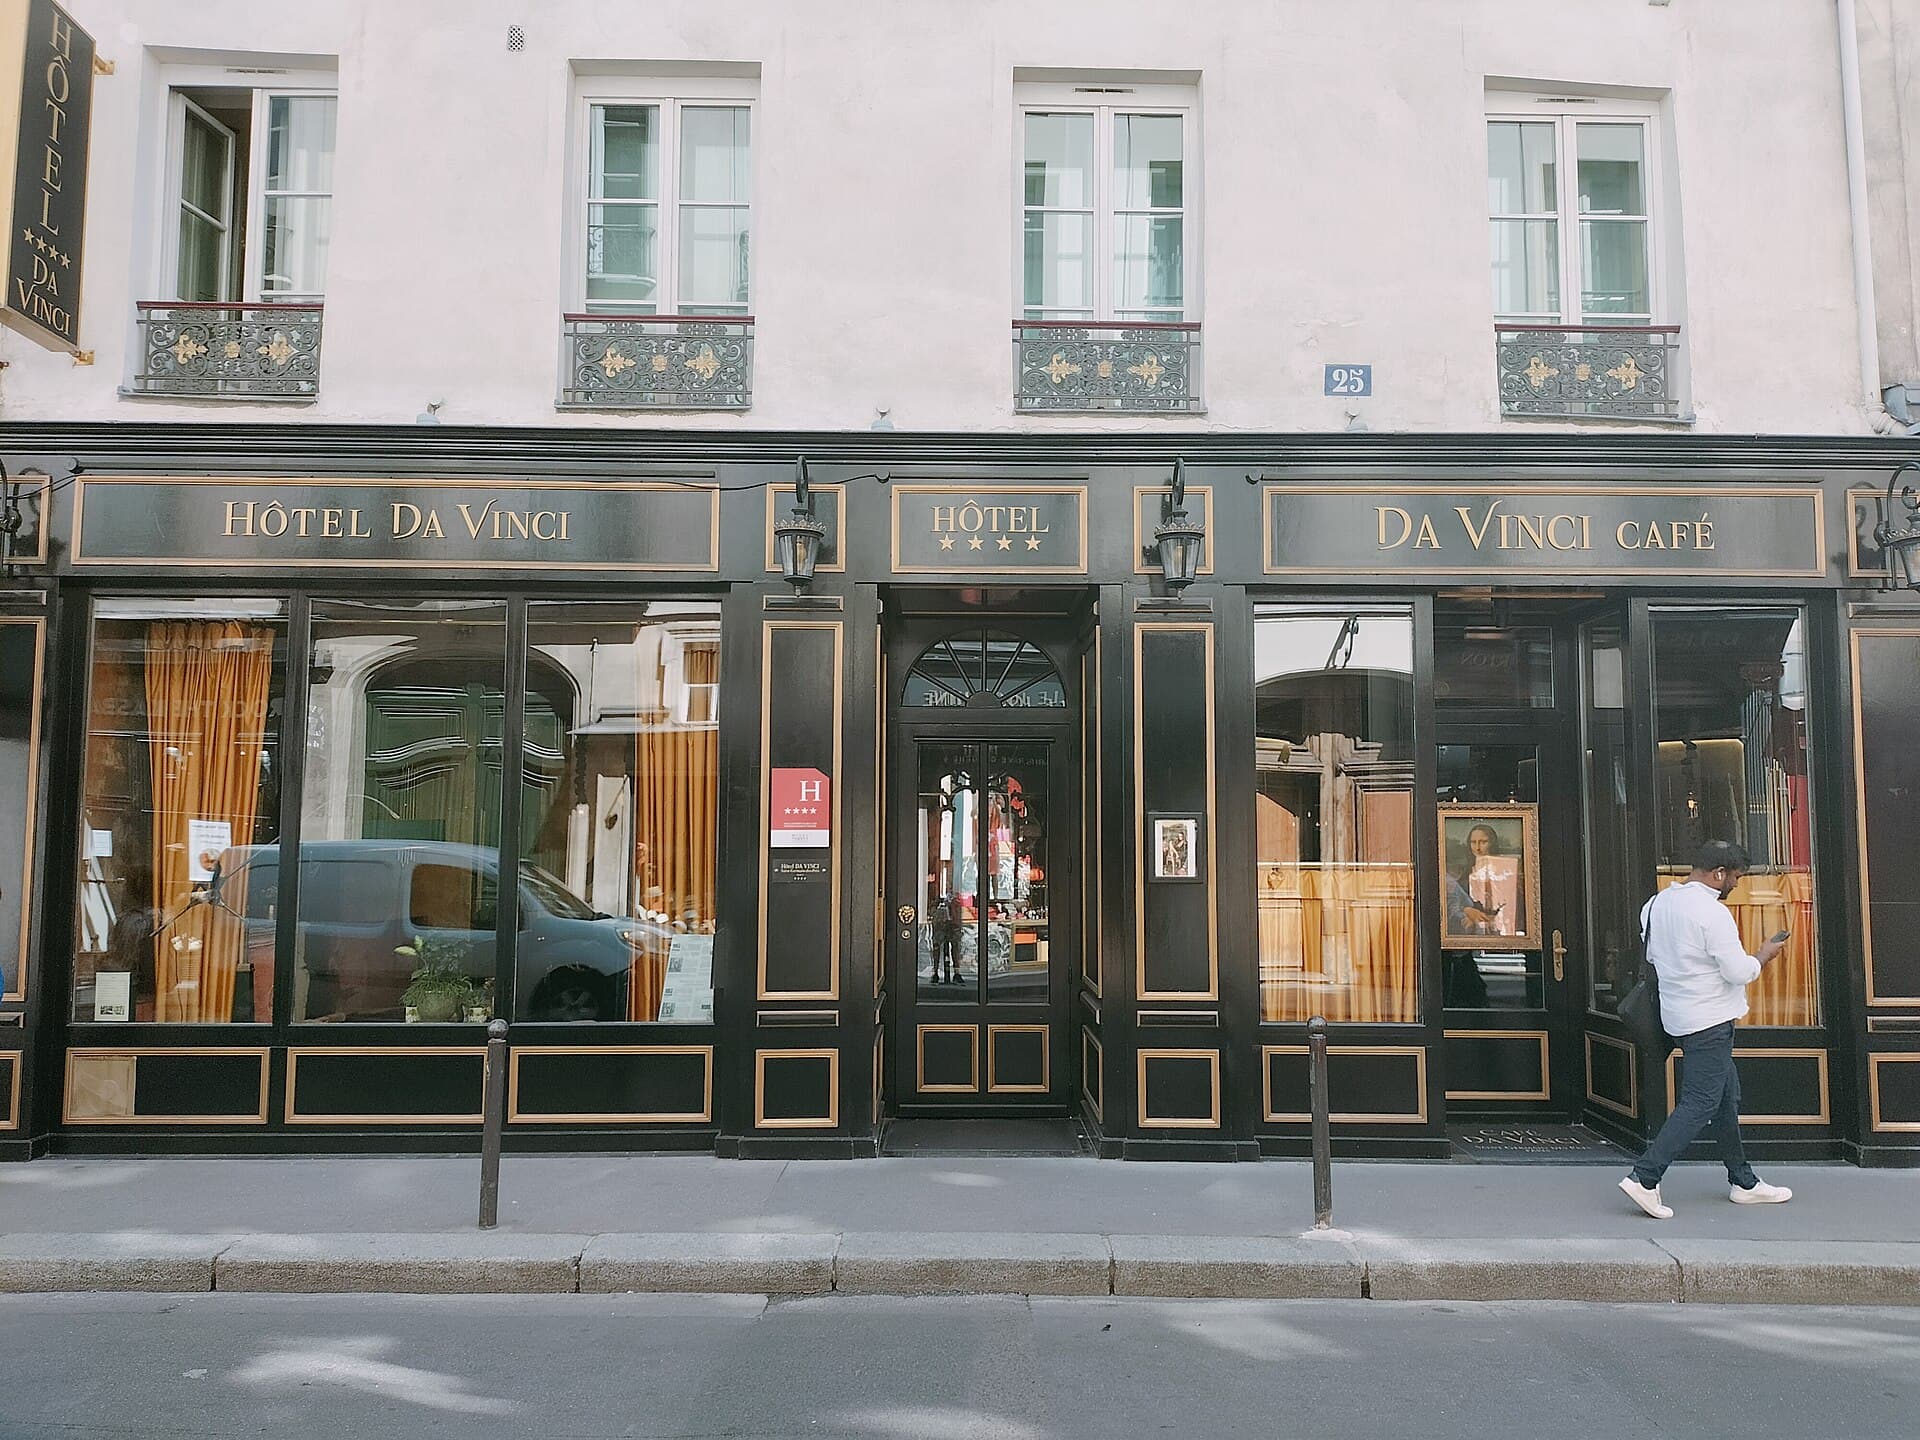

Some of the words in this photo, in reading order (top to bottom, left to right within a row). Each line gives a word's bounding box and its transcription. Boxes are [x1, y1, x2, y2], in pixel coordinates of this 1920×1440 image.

[40, 13, 72, 236] HÔTEL
[33, 253, 60, 298] DA
[16, 276, 71, 336] VINCI
[1331, 368, 1366, 394] 25
[221, 500, 373, 540] HÔTEL
[391, 502, 446, 541] DA
[457, 497, 572, 542] VINCI
[930, 499, 1050, 534] HÔTEL
[1373, 505, 1443, 551] DA
[1453, 499, 1594, 552] VINCI
[1615, 512, 1716, 551] CAFÉ
[799, 780, 823, 802] H
